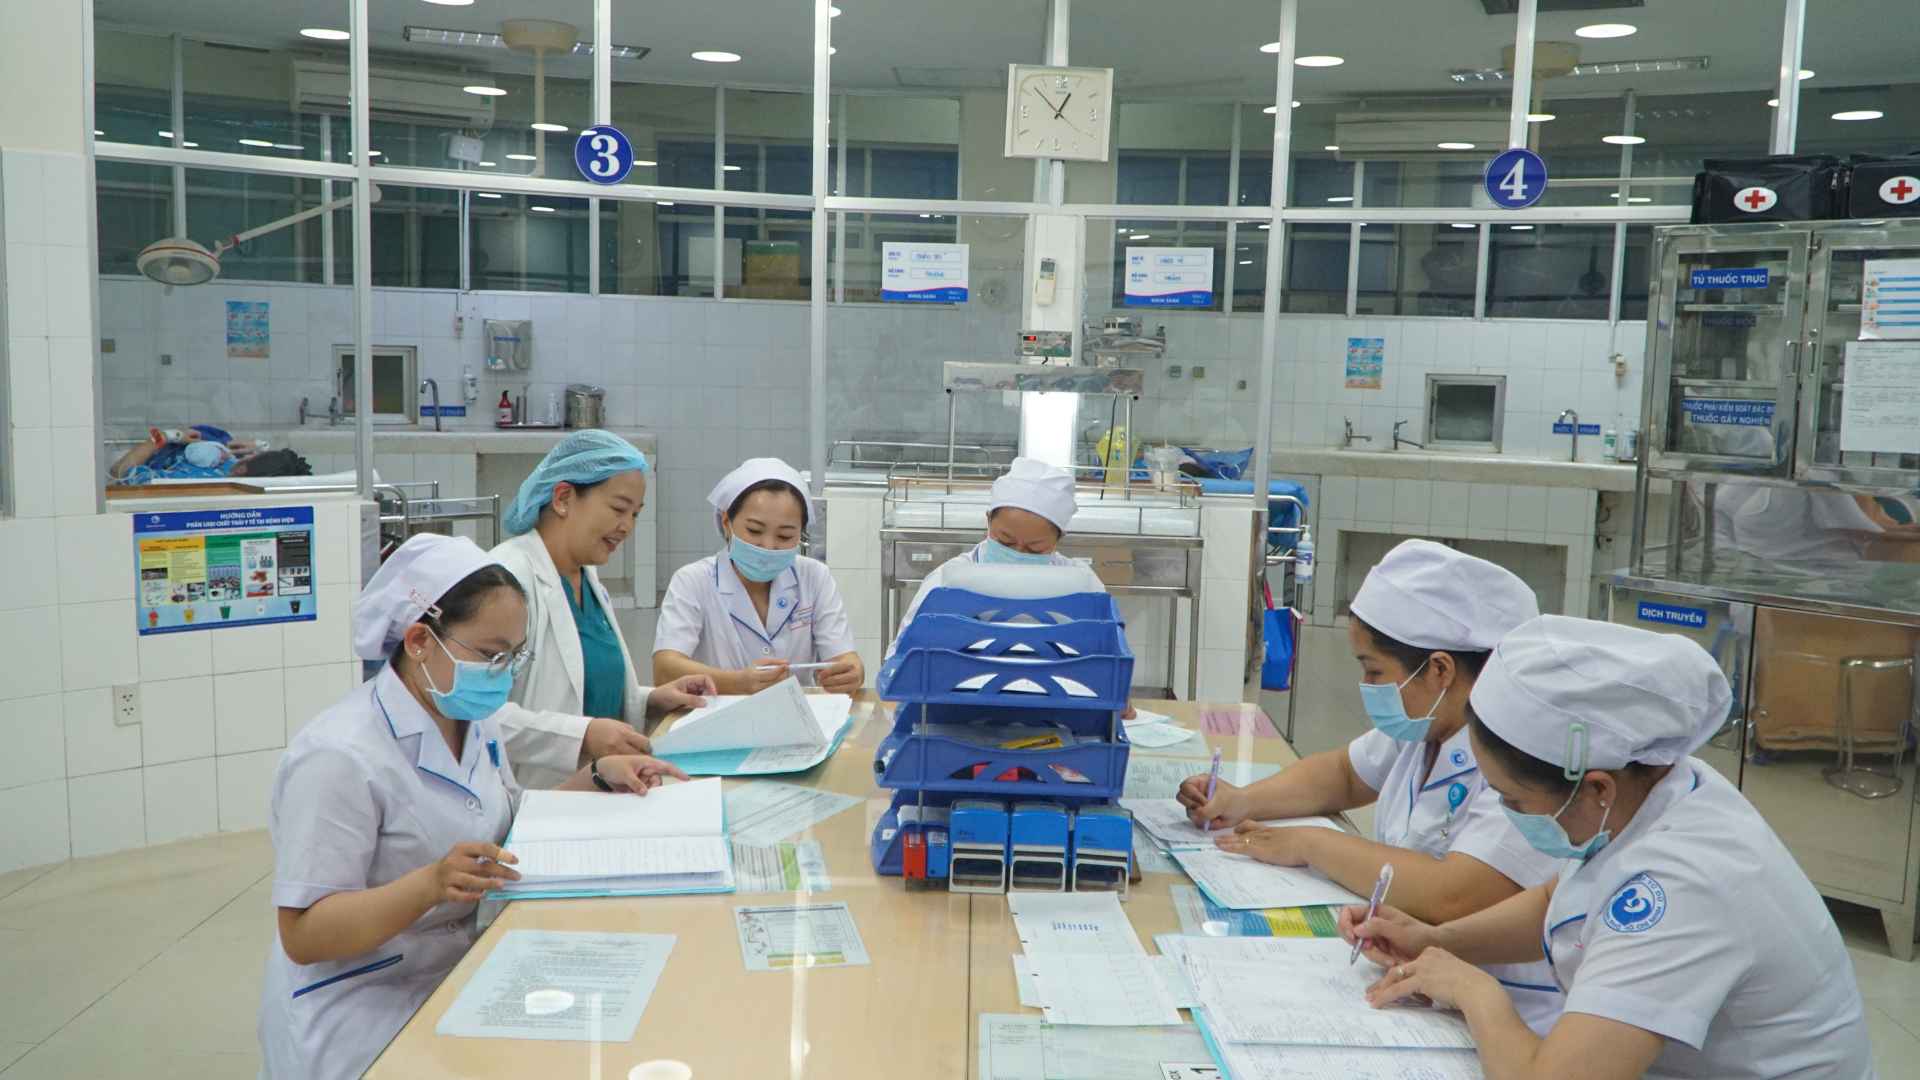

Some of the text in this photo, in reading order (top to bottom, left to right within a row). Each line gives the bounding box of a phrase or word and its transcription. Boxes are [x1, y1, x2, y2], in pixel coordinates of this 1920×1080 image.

[590, 134, 620, 177] 3
[1499, 157, 1529, 200] 4
[1693, 273, 1705, 285] TỦ
[1707, 272, 1739, 284] THUỐC
